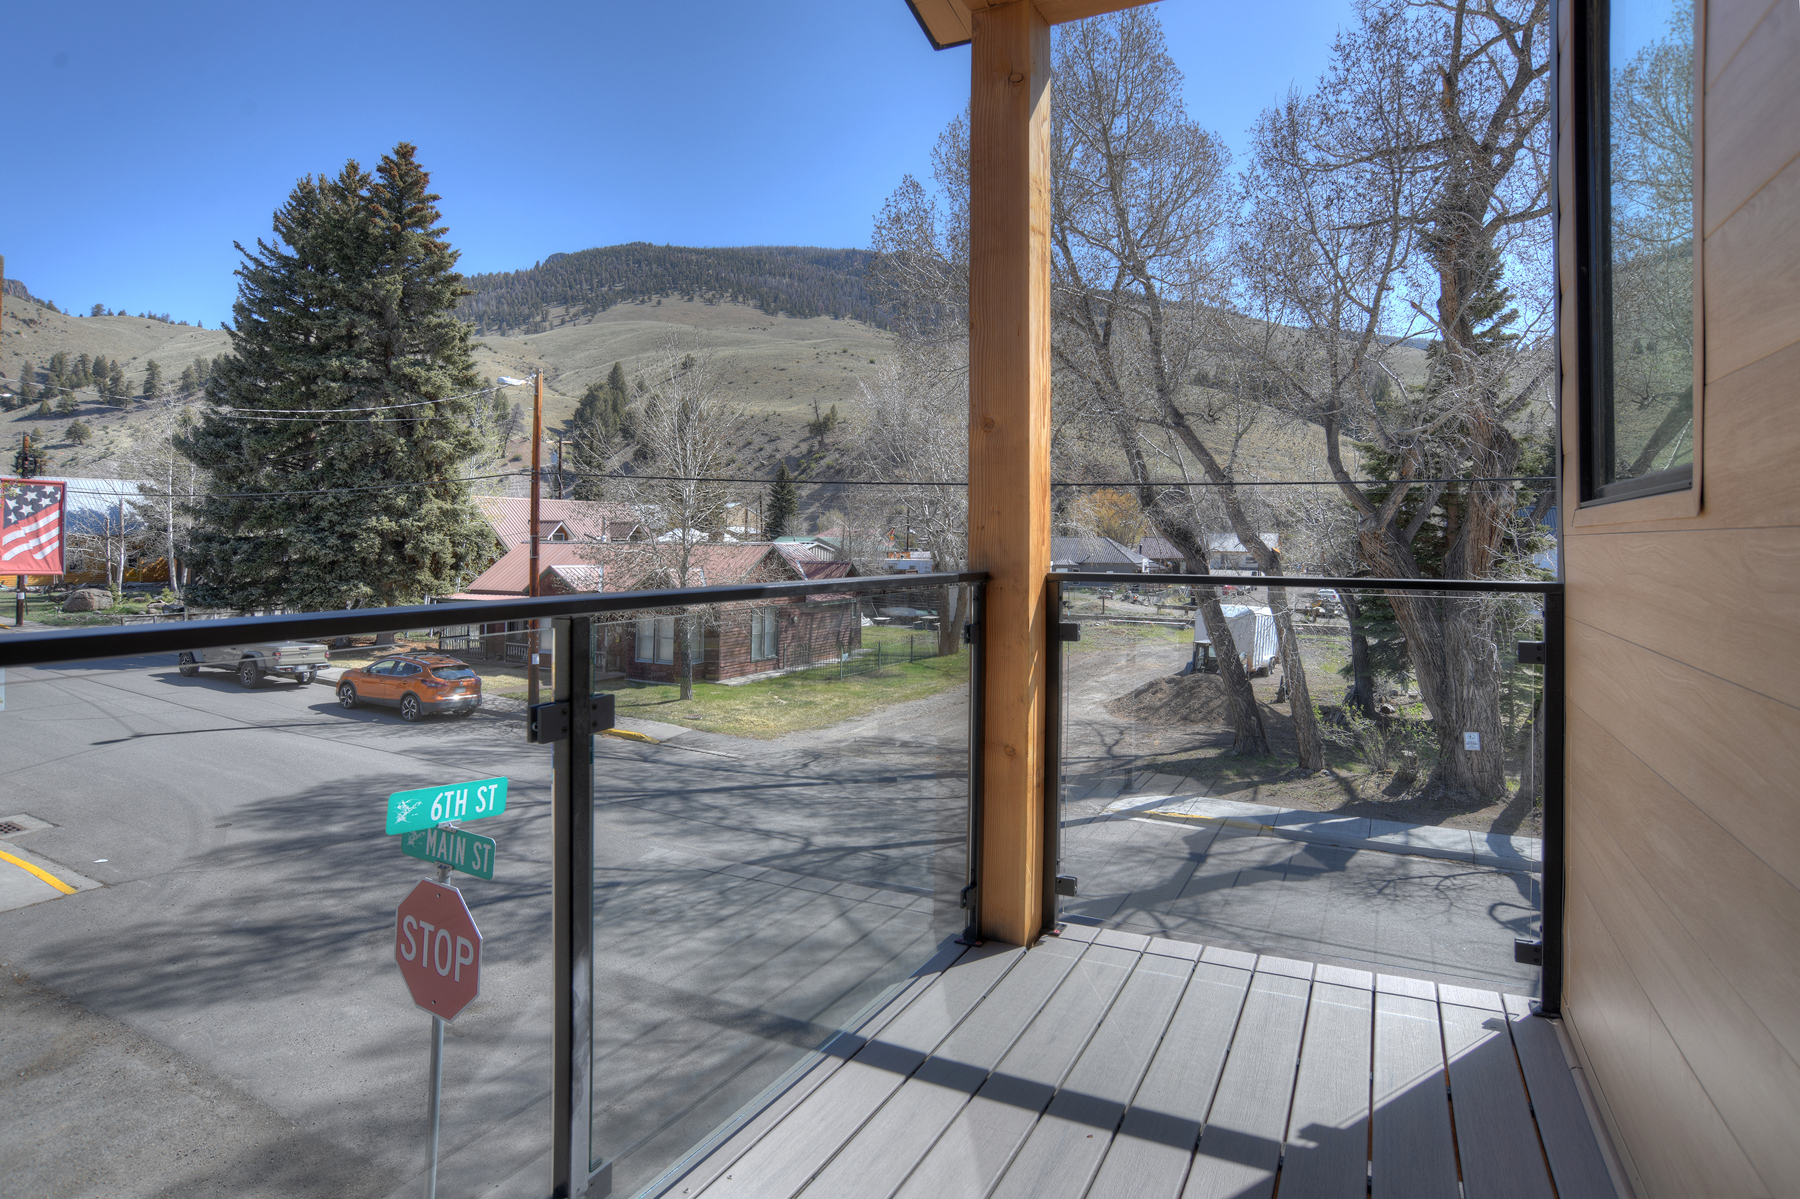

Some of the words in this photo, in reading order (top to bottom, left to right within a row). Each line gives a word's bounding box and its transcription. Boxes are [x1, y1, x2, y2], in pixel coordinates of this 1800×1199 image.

[430, 788, 468, 821] 6TH
[475, 784, 498, 813] ST
[425, 828, 466, 866] MAIN
[472, 841, 491, 873] ST
[400, 915, 474, 983] STOP
